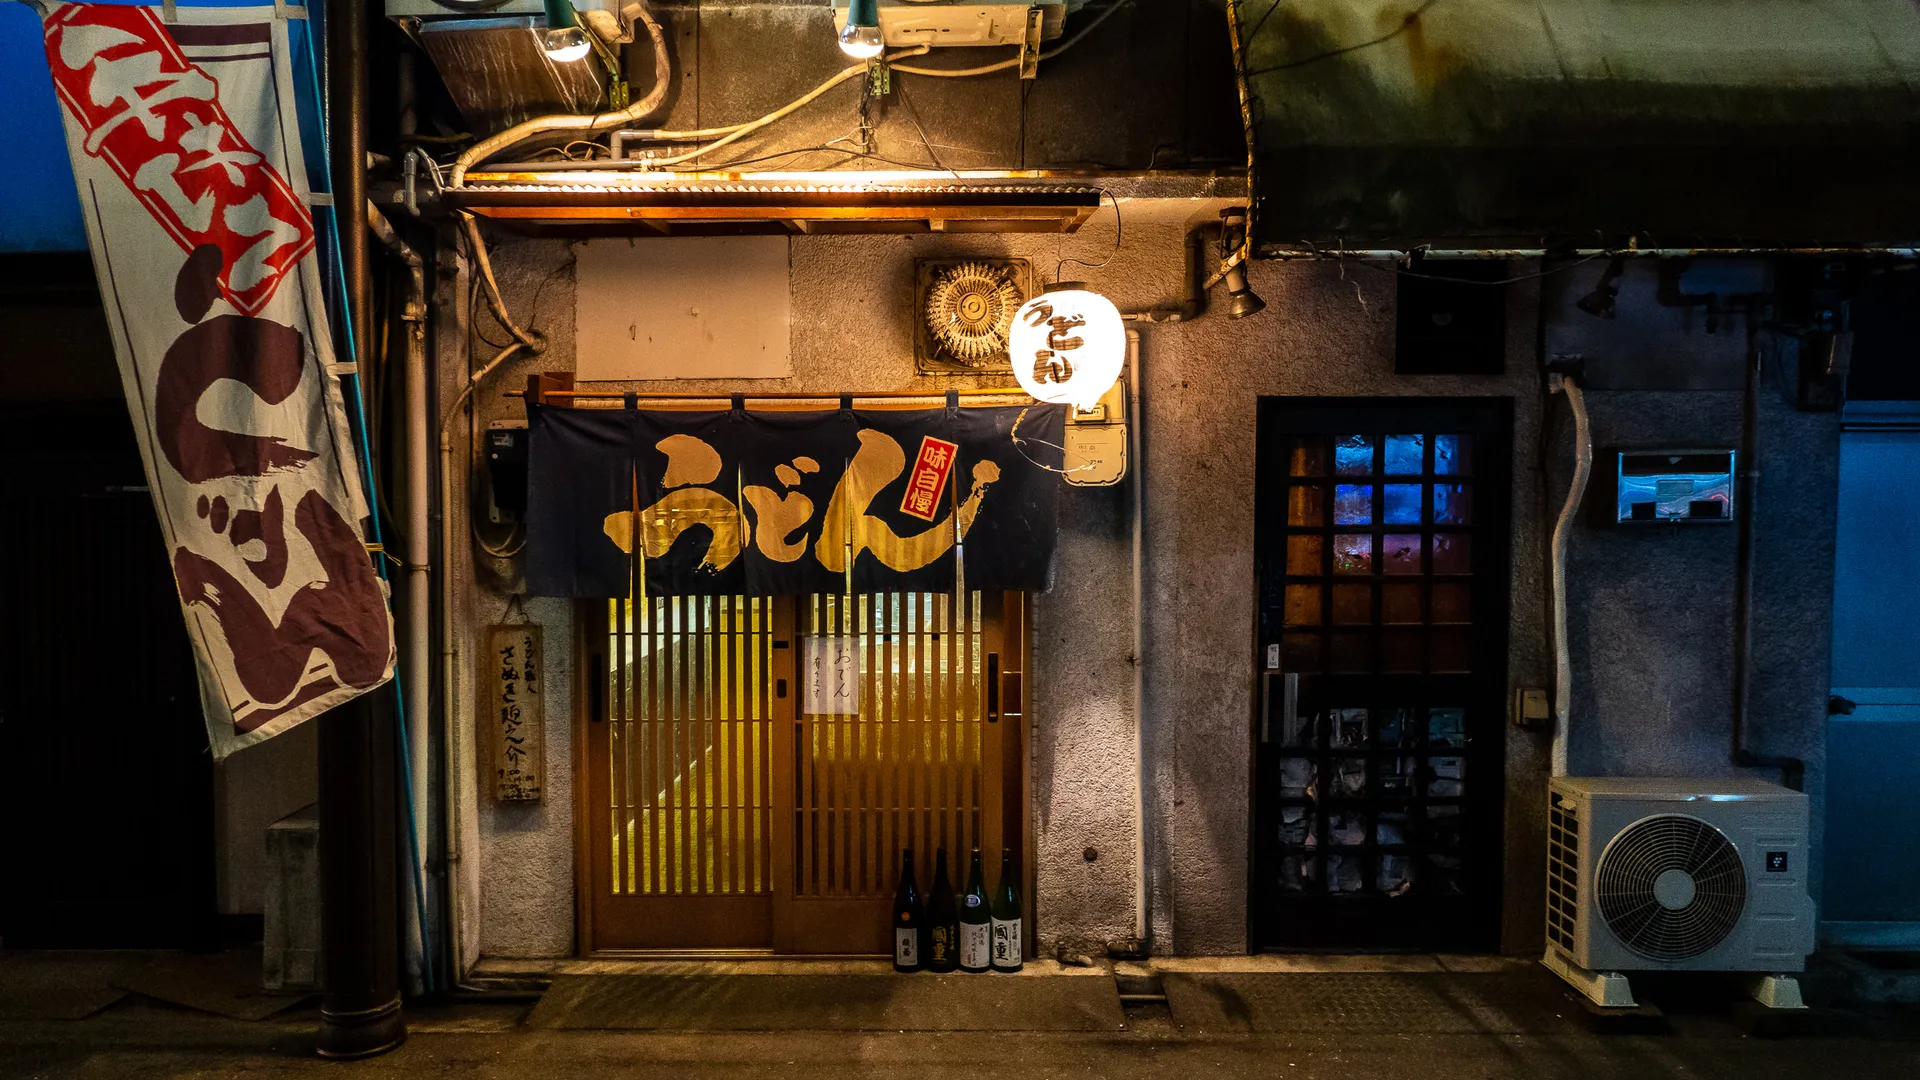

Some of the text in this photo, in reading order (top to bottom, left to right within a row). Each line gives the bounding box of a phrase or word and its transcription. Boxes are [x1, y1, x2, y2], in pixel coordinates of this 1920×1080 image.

[1023, 299, 1086, 384] うどん
[603, 428, 1001, 576] うどん
[910, 446, 948, 514] 味自慢
[834, 648, 851, 698] おでん
